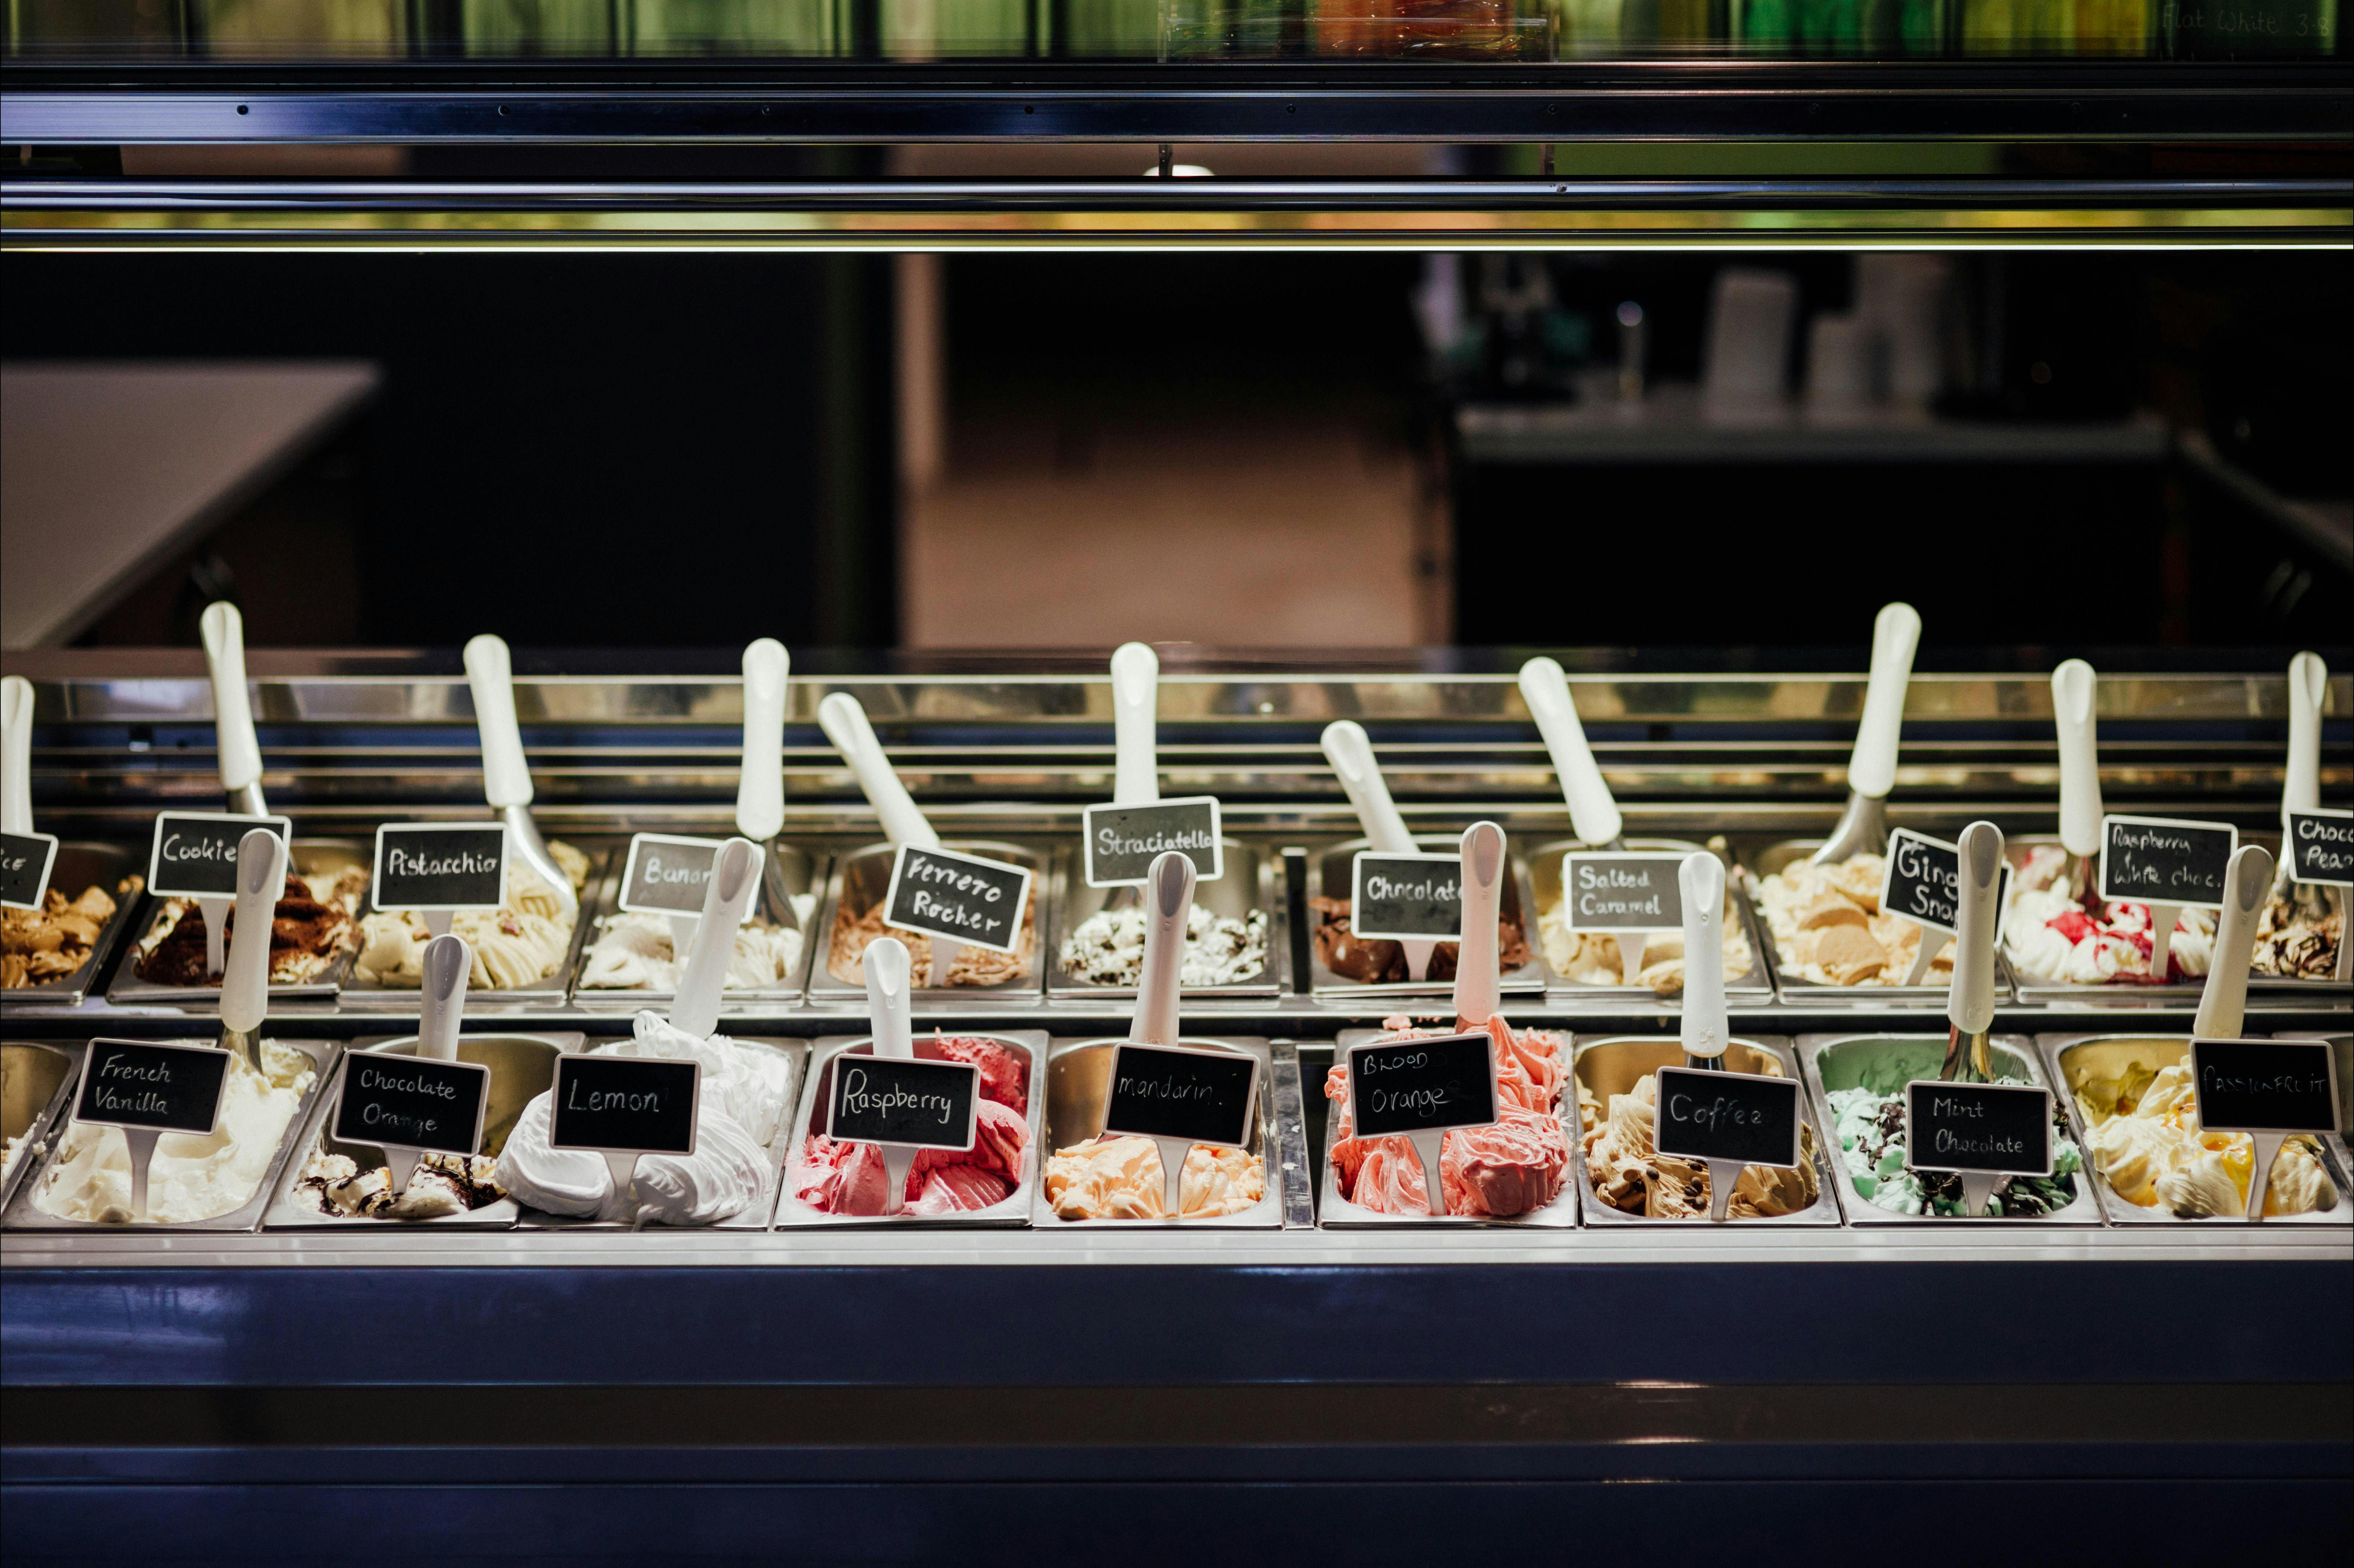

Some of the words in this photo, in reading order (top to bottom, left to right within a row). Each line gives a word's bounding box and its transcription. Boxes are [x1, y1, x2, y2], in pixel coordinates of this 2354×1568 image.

[2217, 9, 2280, 34] White
[163, 833, 237, 862] Cookie
[2112, 824, 2191, 854] Raspberry
[389, 848, 497, 876] Pistacchio
[644, 856, 712, 884] Banan
[1898, 841, 1958, 901] Ging
[908, 856, 1001, 902] Ferrero
[1579, 865, 1650, 890] Salted
[913, 890, 1001, 931] Rocher
[1580, 893, 1661, 916] Caramel
[101, 1054, 170, 1082] French
[361, 1069, 456, 1100] Chocolate
[569, 1079, 660, 1112] Lemon
[842, 1068, 951, 1124] Raspberry
[95, 1086, 168, 1114] Vanilla
[1372, 1088, 1452, 1117] Orange
[1671, 1094, 1762, 1132] Coffee
[1933, 1097, 1984, 1118] Mint
[363, 1103, 437, 1138] Orange
[1935, 1128, 2023, 1153] Chocolate
